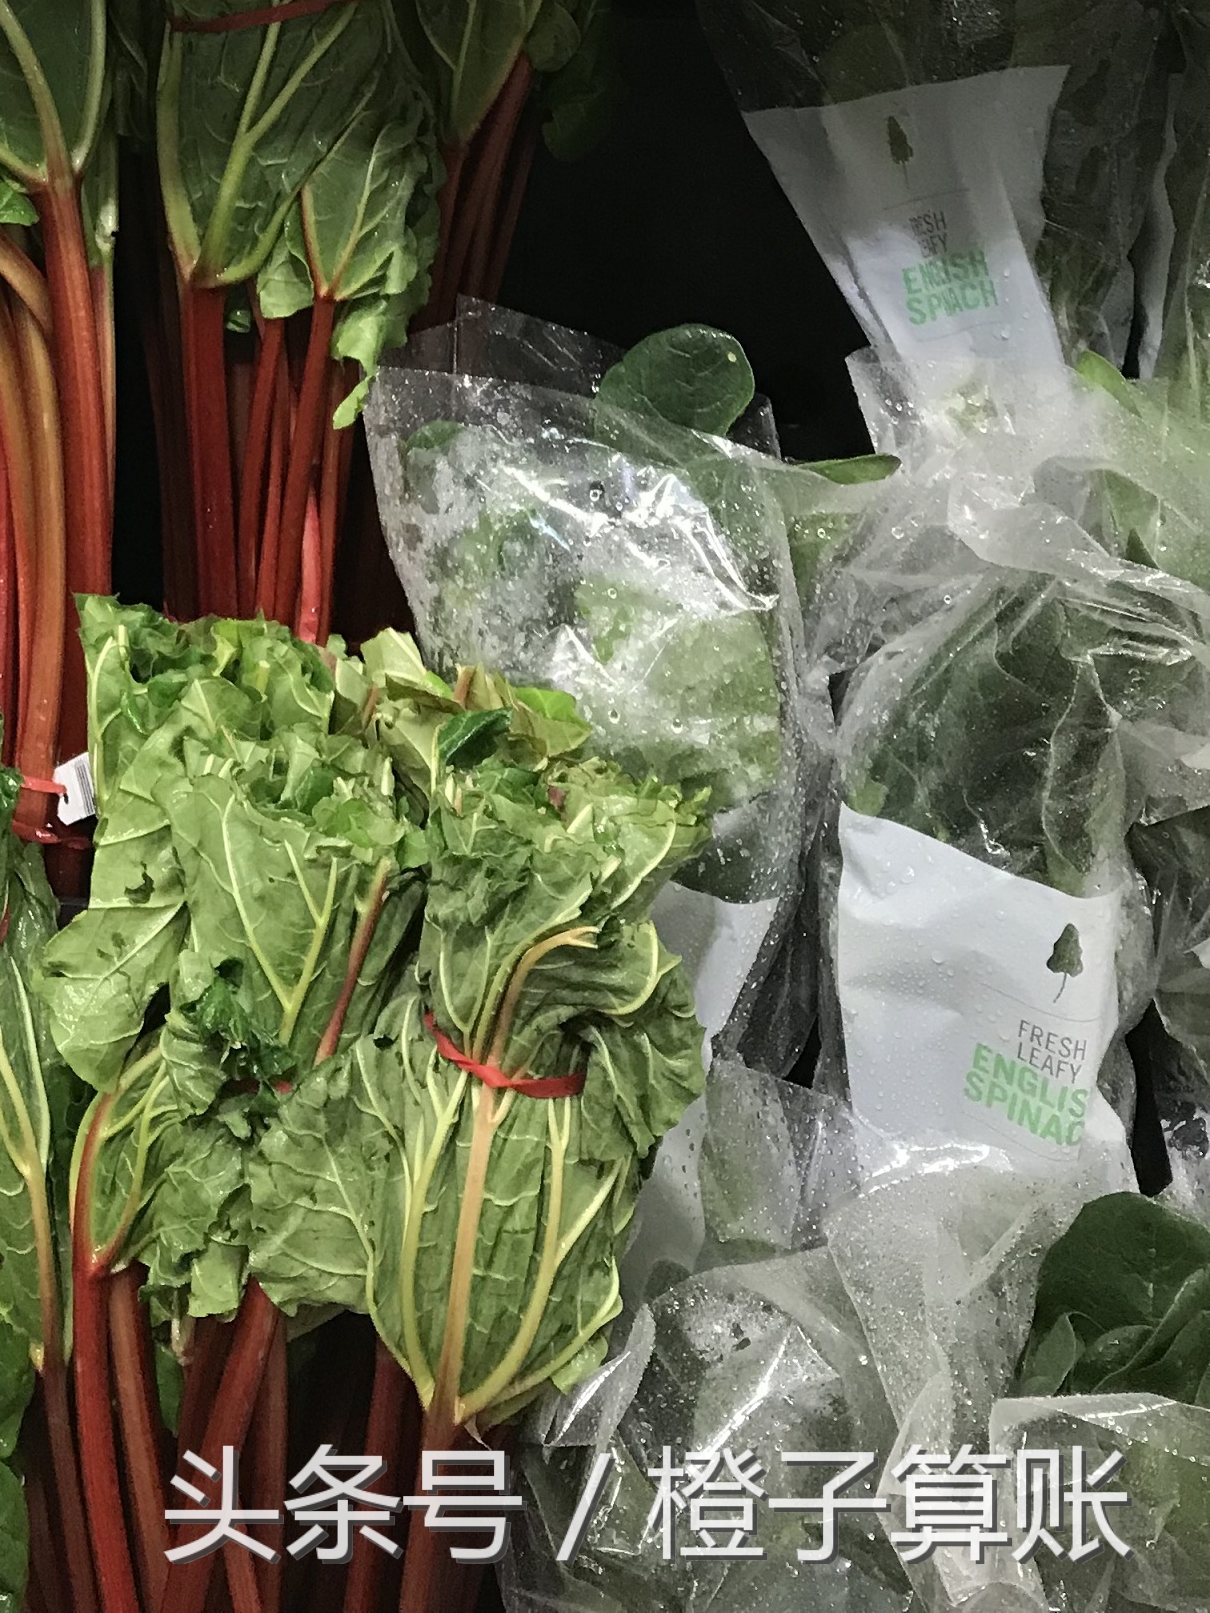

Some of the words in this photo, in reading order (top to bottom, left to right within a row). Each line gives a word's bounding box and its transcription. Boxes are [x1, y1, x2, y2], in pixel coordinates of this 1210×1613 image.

[1016, 1042, 1082, 1084] LEAFY
[1018, 1019, 1087, 1061] FRESH
[963, 1070, 1086, 1146] SPINAC
[972, 1043, 1088, 1118] ENGLIS
